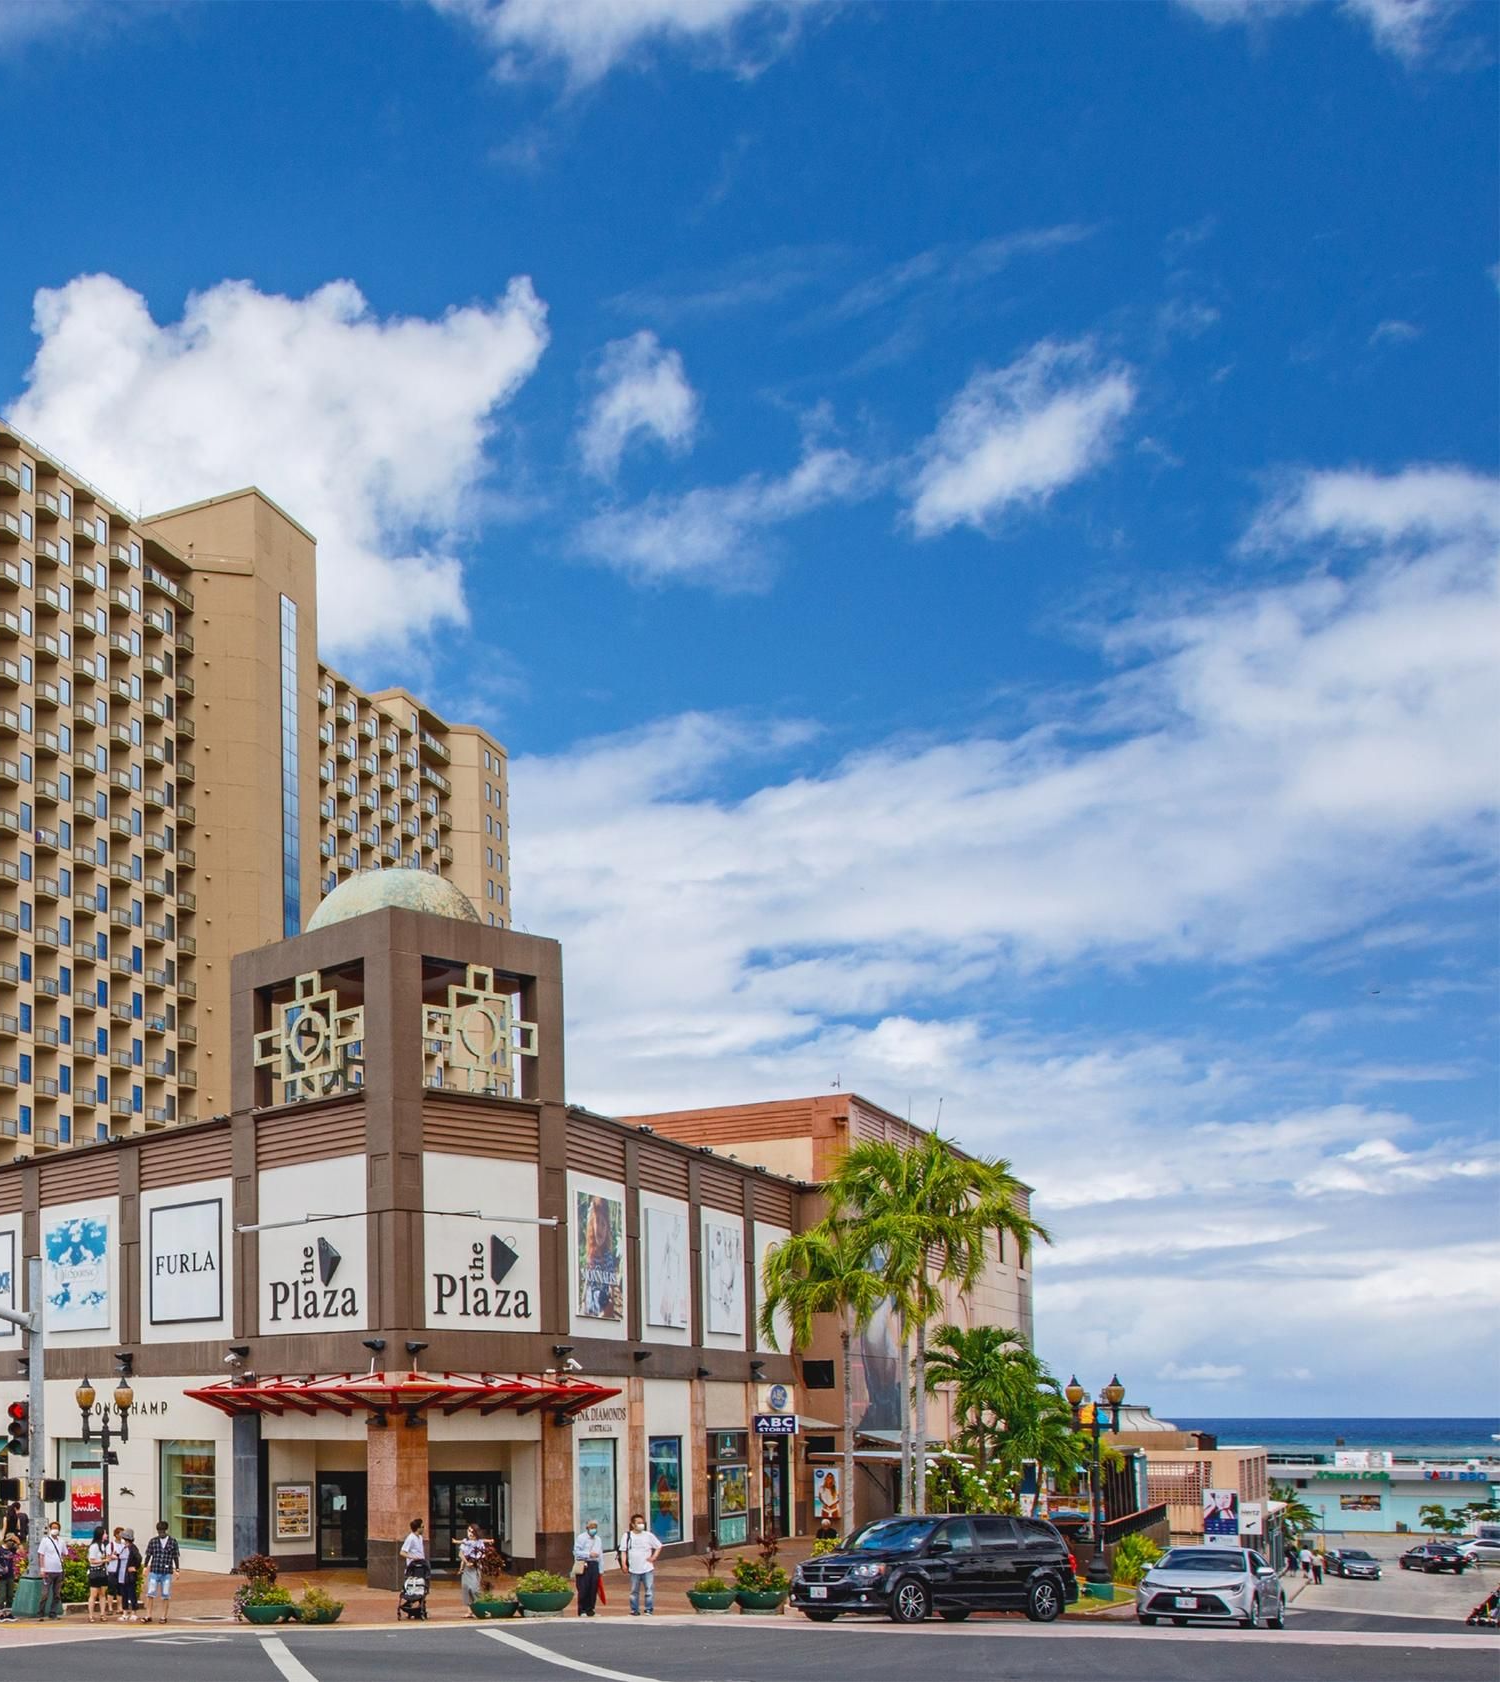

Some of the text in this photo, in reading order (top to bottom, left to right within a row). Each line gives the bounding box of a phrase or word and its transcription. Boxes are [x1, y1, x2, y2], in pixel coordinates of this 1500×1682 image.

[155, 1250, 216, 1276] FURLA
[301, 1246, 314, 1286] the
[469, 1242, 484, 1283] the
[269, 1279, 359, 1322] Plaza
[433, 1273, 532, 1319] Plaza
[88, 1401, 168, 1416] ONGHAMP
[757, 1417, 794, 1428] ABC
[72, 1501, 101, 1513] Smith
